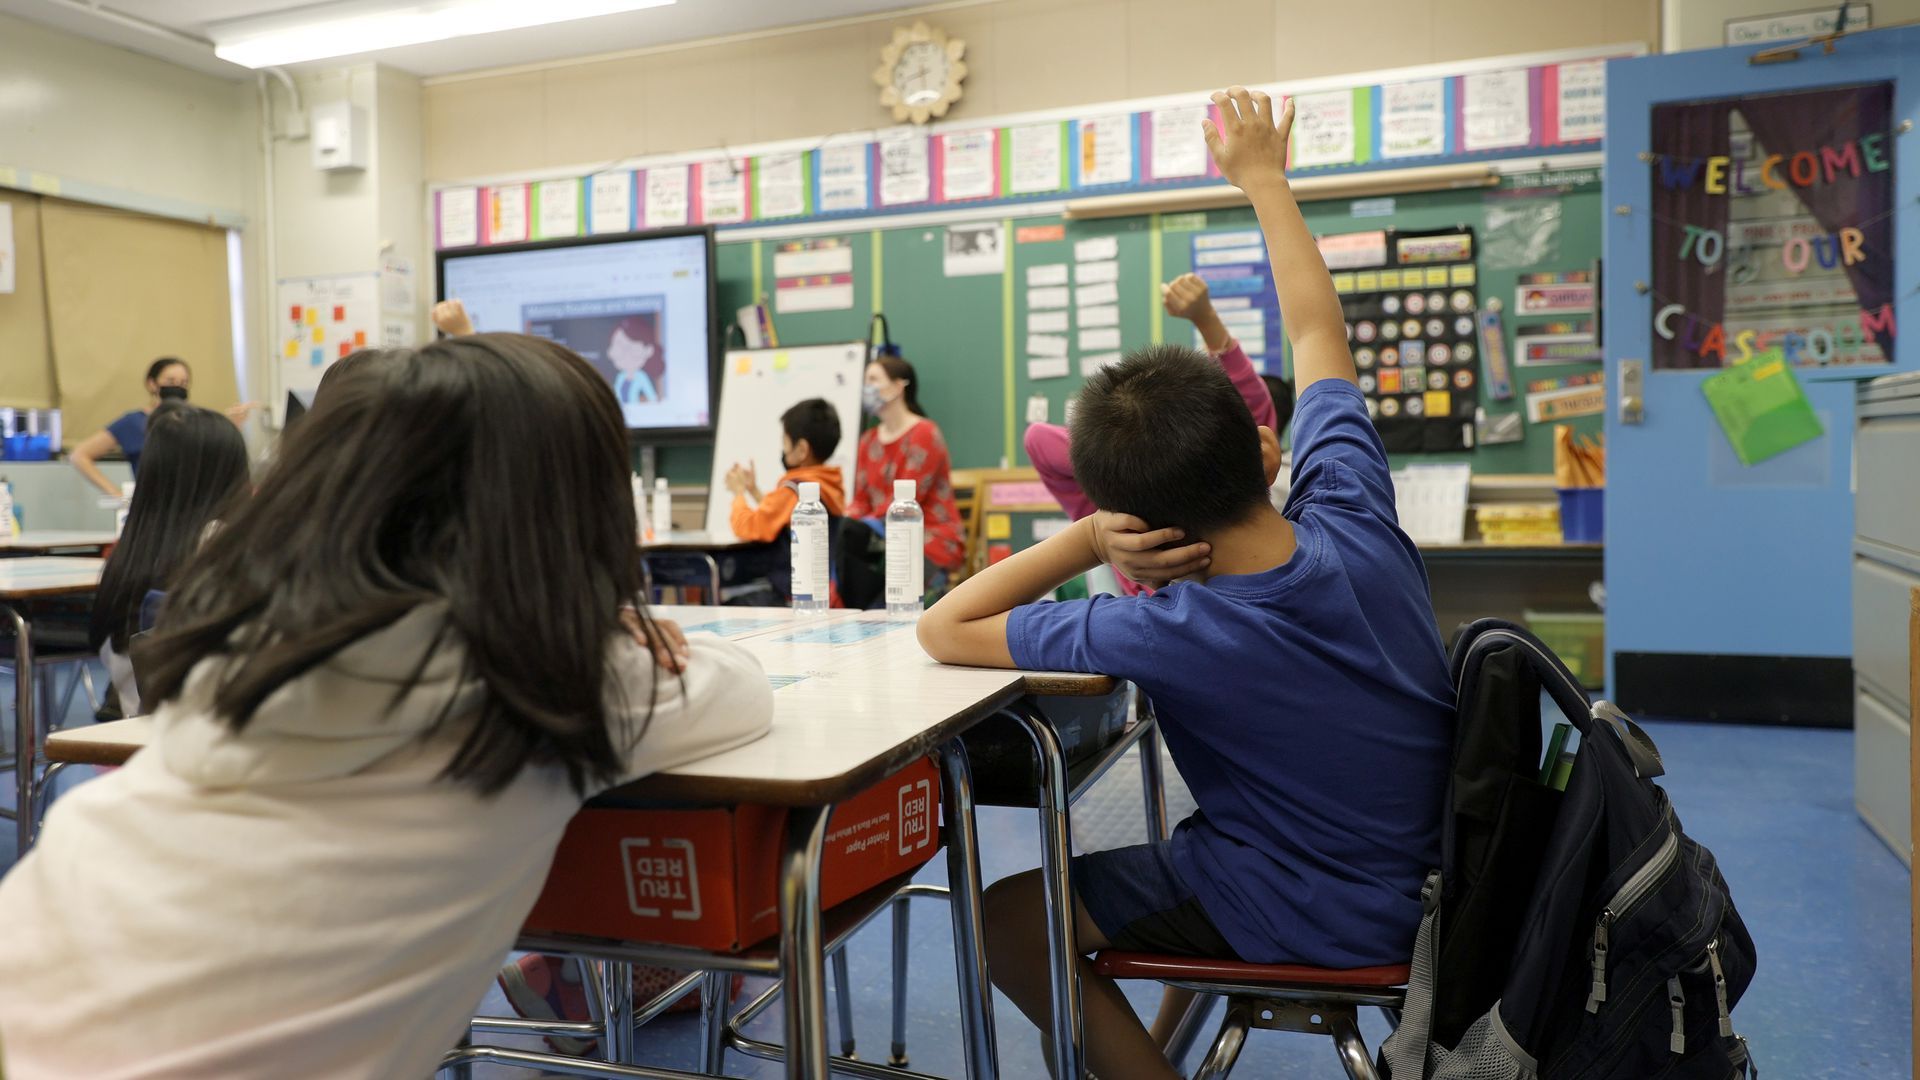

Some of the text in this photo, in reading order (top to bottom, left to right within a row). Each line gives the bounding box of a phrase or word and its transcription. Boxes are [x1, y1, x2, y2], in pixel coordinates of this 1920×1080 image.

[1661, 134, 1889, 194] WELCOME
[1678, 225, 1867, 273] TO OUR
[904, 796, 925, 817] RED
[857, 819, 871, 832] Black
[904, 815, 925, 837] TRU
[845, 829, 890, 855] Printer Paper
[636, 857, 685, 878] RED
[639, 878, 687, 900] TRU
